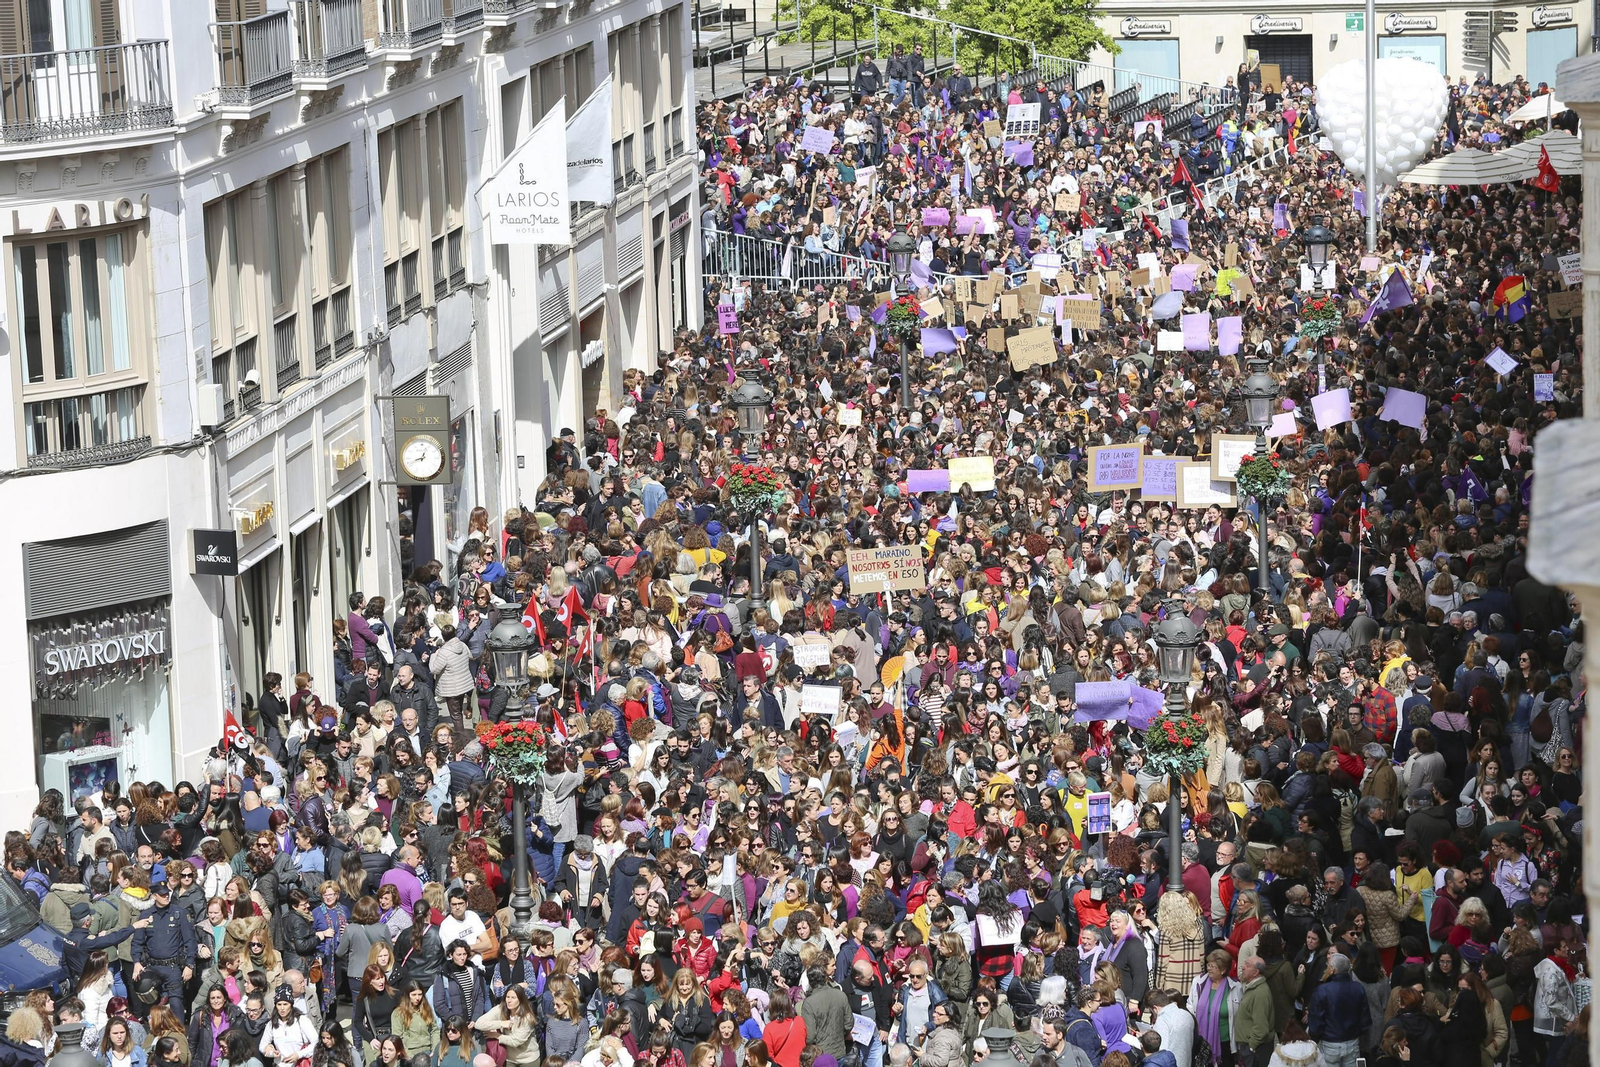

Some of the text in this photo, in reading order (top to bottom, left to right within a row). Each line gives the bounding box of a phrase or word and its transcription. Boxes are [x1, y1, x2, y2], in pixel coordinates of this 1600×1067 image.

[497, 192, 560, 207] LARIOS
[12, 193, 149, 235] LARIOS
[1154, 462, 1163, 470] SE
[196, 554, 231, 564] SWAROVSKI
[852, 561, 891, 573] NOSOTRXS
[906, 558, 922, 567] NOS
[853, 571, 887, 583] METEMOS
[888, 570, 898, 580] EN
[44, 631, 165, 675] SWAROVSKI
[794, 644, 828, 655] STRONGER
[795, 654, 829, 666] TOGETHER
